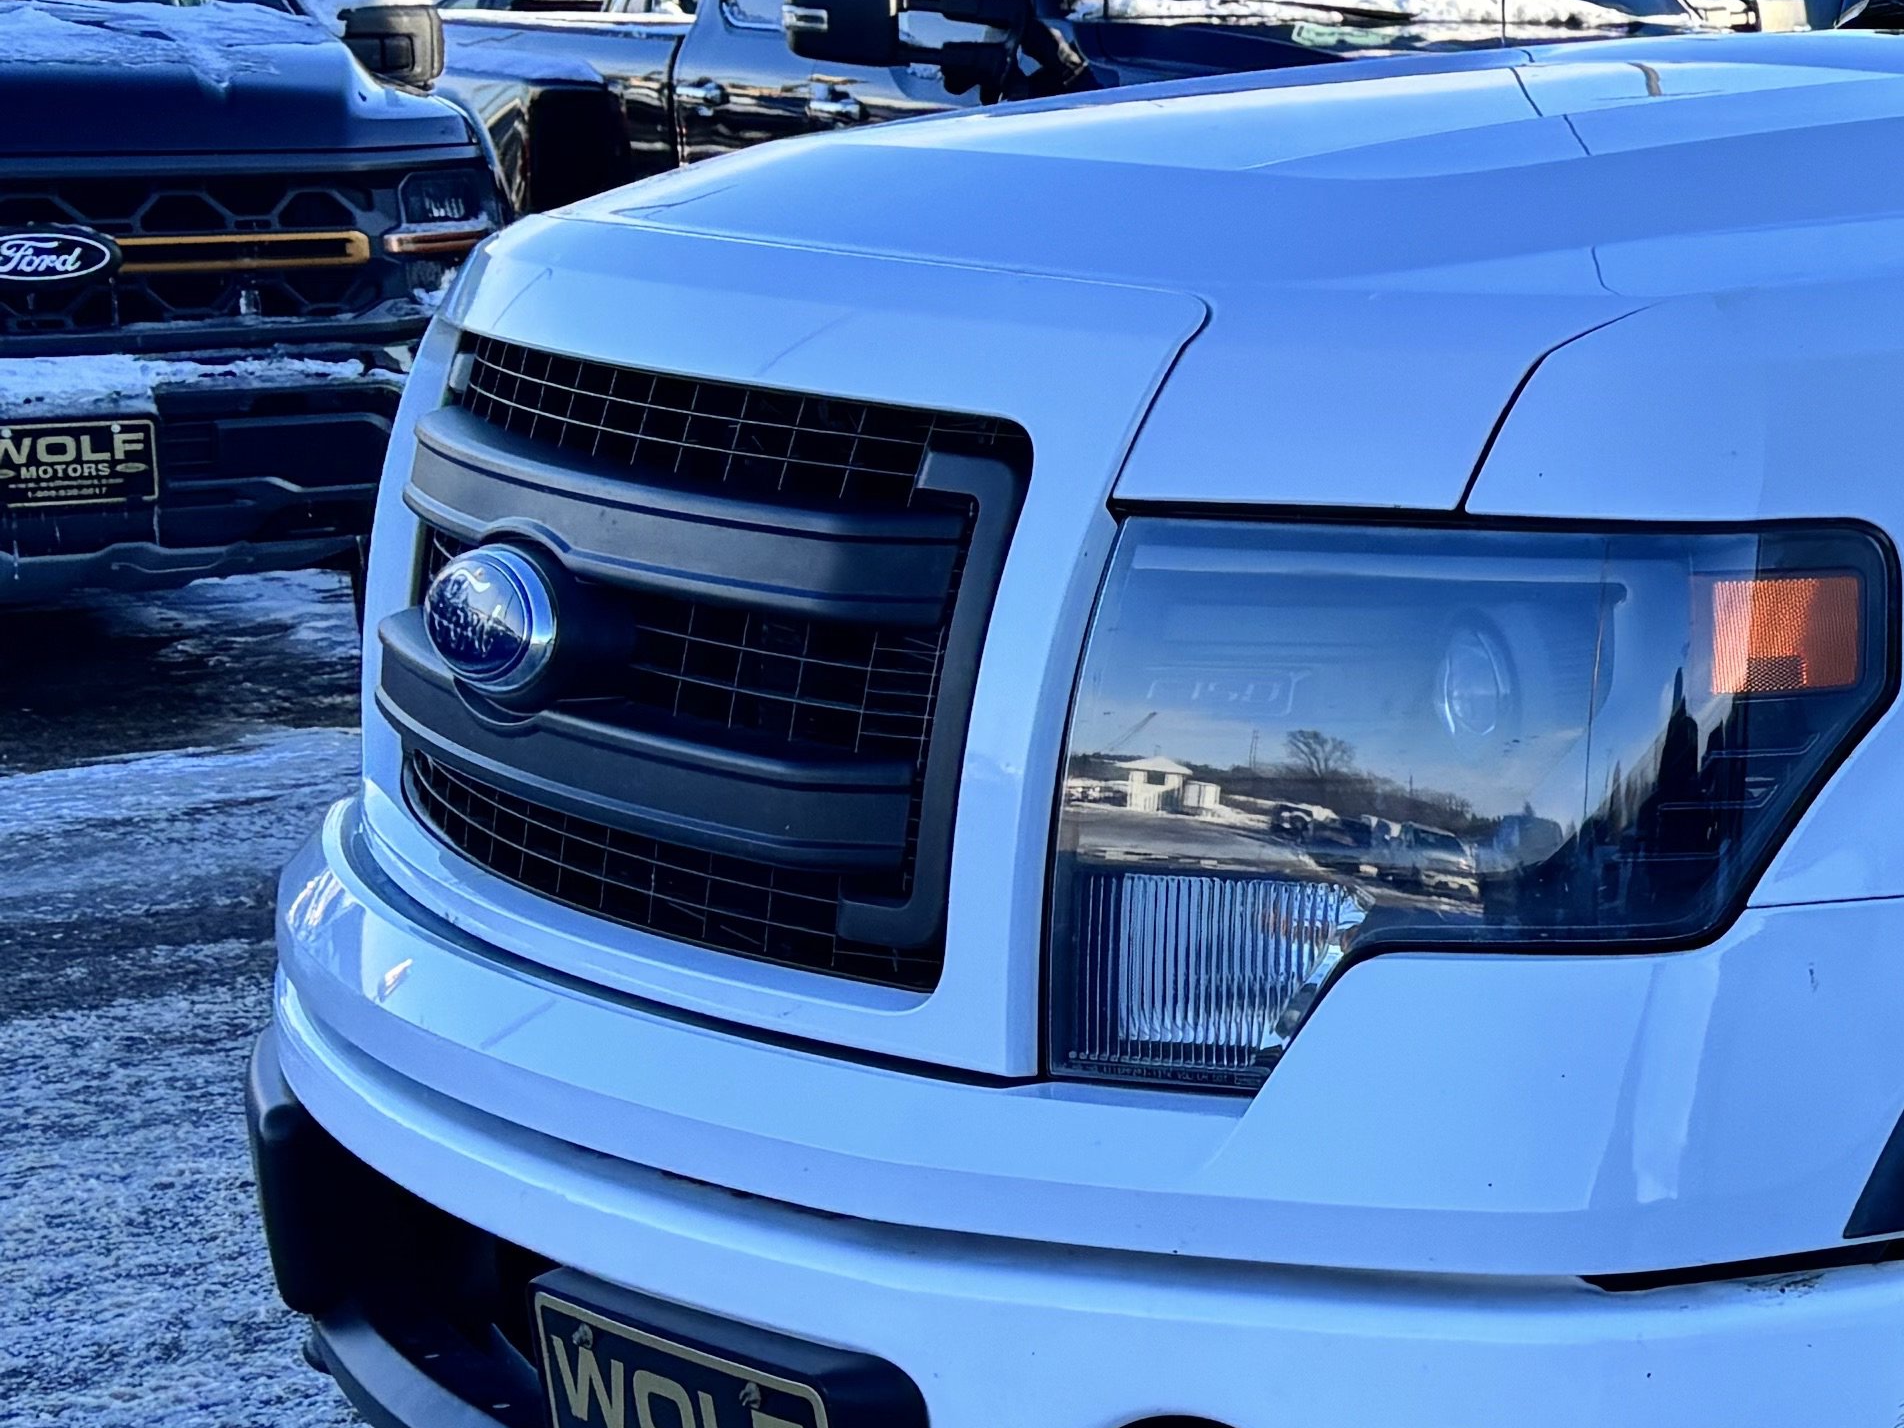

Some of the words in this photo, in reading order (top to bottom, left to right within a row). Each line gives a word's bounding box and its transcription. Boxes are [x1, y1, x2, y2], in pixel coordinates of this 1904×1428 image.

[0, 240, 82, 273] Ford
[0, 433, 144, 464] WOLF
[20, 463, 111, 480] MOTORS
